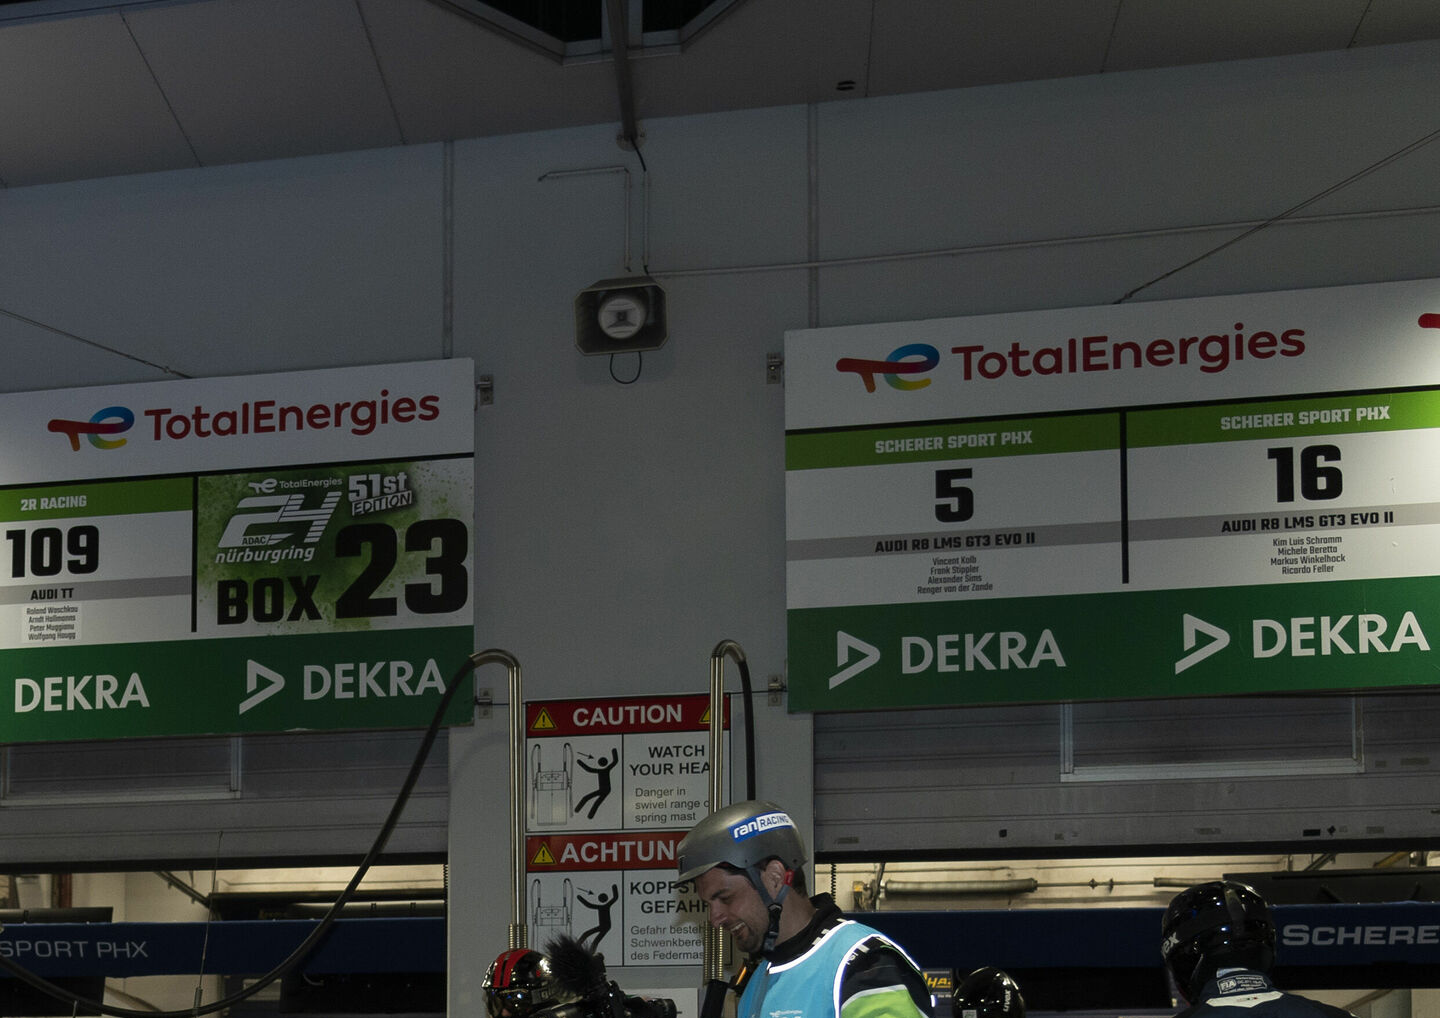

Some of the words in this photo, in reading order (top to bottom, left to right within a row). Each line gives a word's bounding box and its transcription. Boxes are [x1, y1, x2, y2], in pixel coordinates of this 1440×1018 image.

[951, 322, 1306, 382] TotalEnergies
[145, 389, 440, 443] TotalEnergies
[1220, 412, 1294, 430] SCHERER
[1298, 409, 1352, 425] SPORT
[1356, 406, 1391, 421] PHX
[875, 436, 943, 454] SCHERER
[947, 432, 998, 449] SPORT
[1001, 430, 1033, 445] PHX
[279, 478, 343, 489] TotalEnergies
[1267, 444, 1343, 503] 16
[348, 471, 408, 502] 51st
[935, 468, 974, 523] 5
[20, 498, 37, 511] 2R
[40, 495, 87, 510] RACING
[352, 490, 413, 517] EDITION
[1221, 520, 1256, 532] AUDI
[1261, 518, 1279, 530] R8
[1285, 516, 1314, 529] LMS
[1319, 514, 1346, 527] GT3
[1351, 513, 1379, 525] EVO
[1384, 511, 1394, 523] II
[242, 535, 267, 546] ADAC
[875, 540, 907, 553] AUDI
[912, 538, 929, 550] R8
[934, 537, 961, 549] LMS
[966, 535, 991, 547] GT3
[995, 533, 1022, 546] EVO
[1026, 532, 1035, 544] II
[1272, 538, 1287, 547] Kim
[1289, 537, 1304, 546] Luis
[1306, 536, 1342, 545] Schramm
[6, 525, 100, 578] 109
[214, 545, 315, 565] nürburgring
[1270, 557, 1298, 566] Markus
[1300, 554, 1346, 564] Winkelhock
[1277, 547, 1307, 556] Michele
[1309, 546, 1338, 554] Beretta
[217, 574, 323, 625] BOX
[335, 518, 469, 619] 23
[932, 557, 959, 566] Vincent
[1282, 566, 1311, 575] Ricardo
[1312, 564, 1334, 573] Feller
[928, 575, 963, 584] Alexander
[30, 589, 57, 600] AUDI
[61, 588, 74, 598] TT
[917, 585, 942, 595] Renger
[1252, 611, 1430, 659] DEKRA
[902, 629, 1066, 675] DEKRA
[304, 658, 447, 701] DEKRA
[15, 672, 150, 714] DEKRA
[573, 704, 682, 727] CAUTION
[648, 745, 706, 758] WATCH
[629, 763, 674, 776] YOUR
[635, 787, 674, 798] Danger
[676, 786, 686, 796] in
[635, 799, 668, 810] swivel
[670, 800, 701, 811] range
[635, 812, 668, 824] spring
[670, 811, 696, 821] mast
[733, 820, 759, 839] ran
[760, 812, 791, 830] RACING
[561, 840, 679, 863] ACHTUN
[631, 925, 666, 935] Gefahr
[1282, 923, 1440, 946] SCHERE
[97, 940, 150, 958] PHX
[631, 950, 649, 960] des
[1220, 980, 1235, 990] FIA
